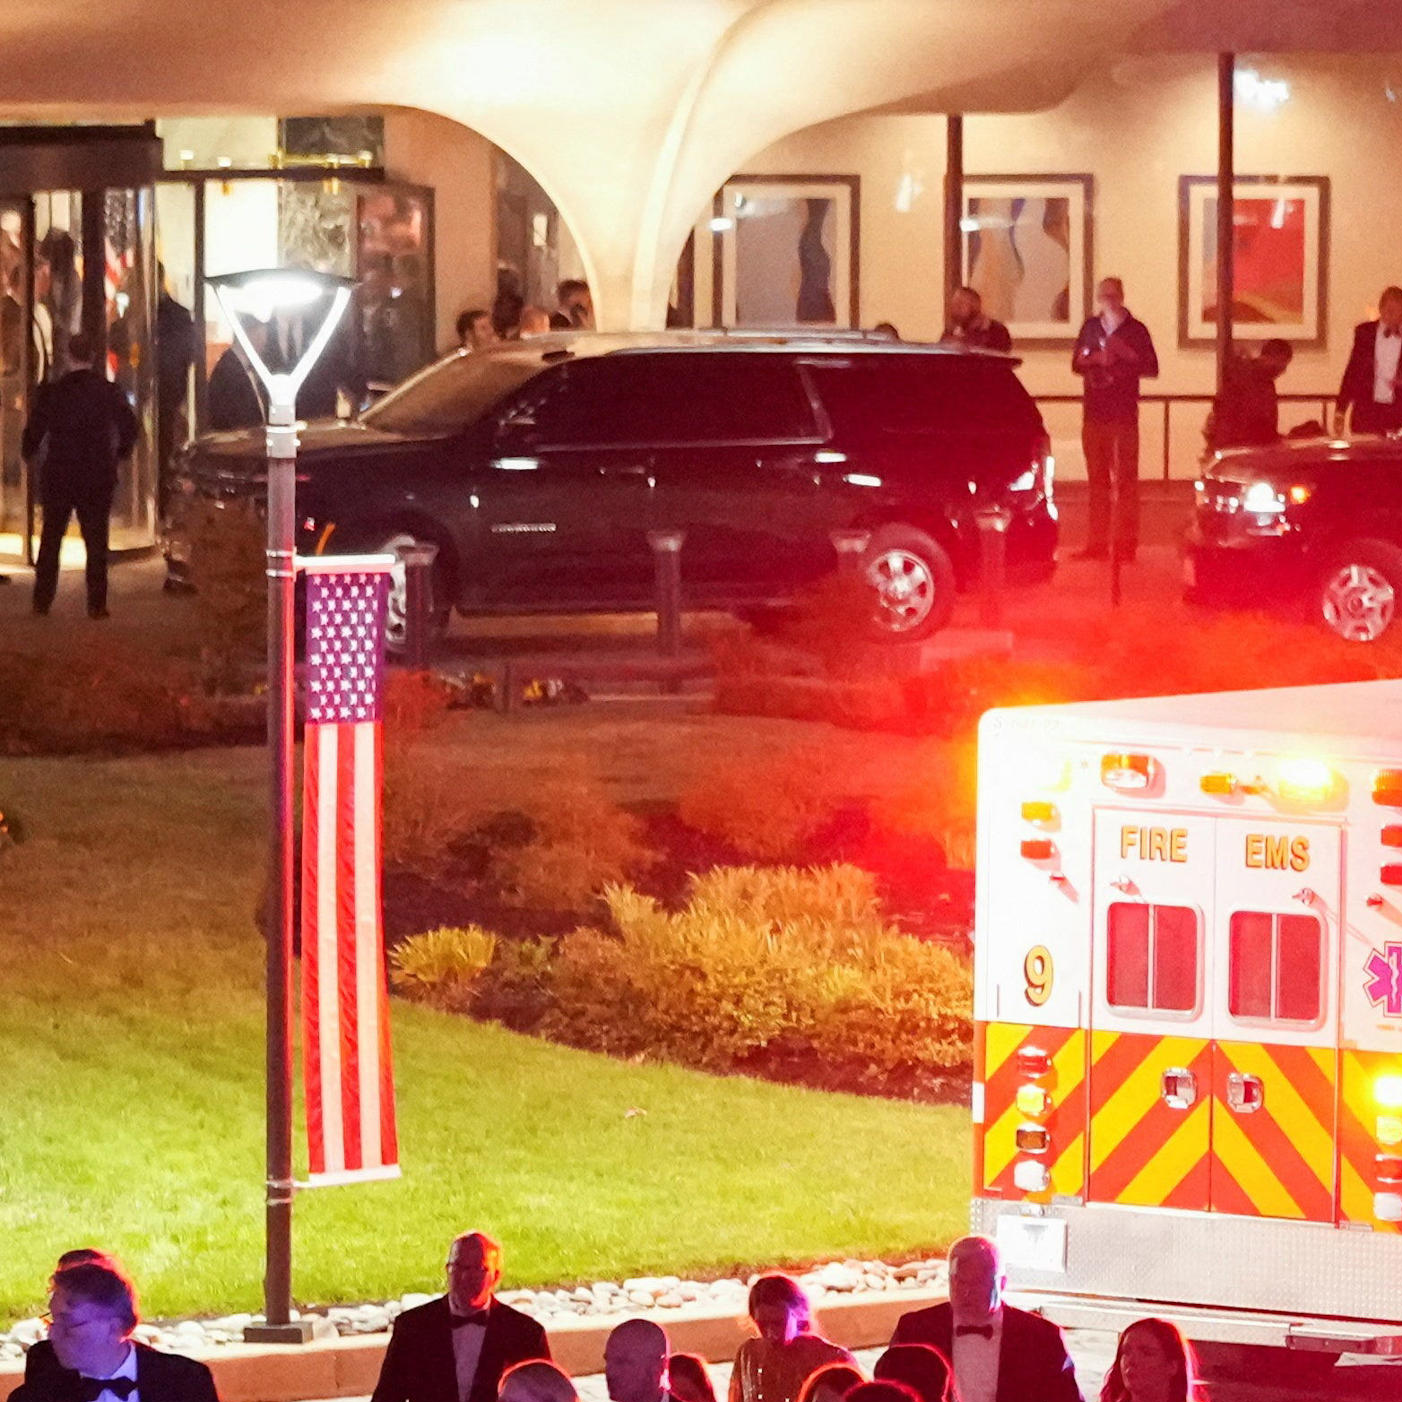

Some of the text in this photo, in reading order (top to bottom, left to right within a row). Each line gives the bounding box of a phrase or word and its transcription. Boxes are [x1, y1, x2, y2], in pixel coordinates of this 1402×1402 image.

[1119, 825, 1188, 863] FIRE
[1245, 834, 1311, 872] EMS
[1024, 945, 1054, 1007] 9
